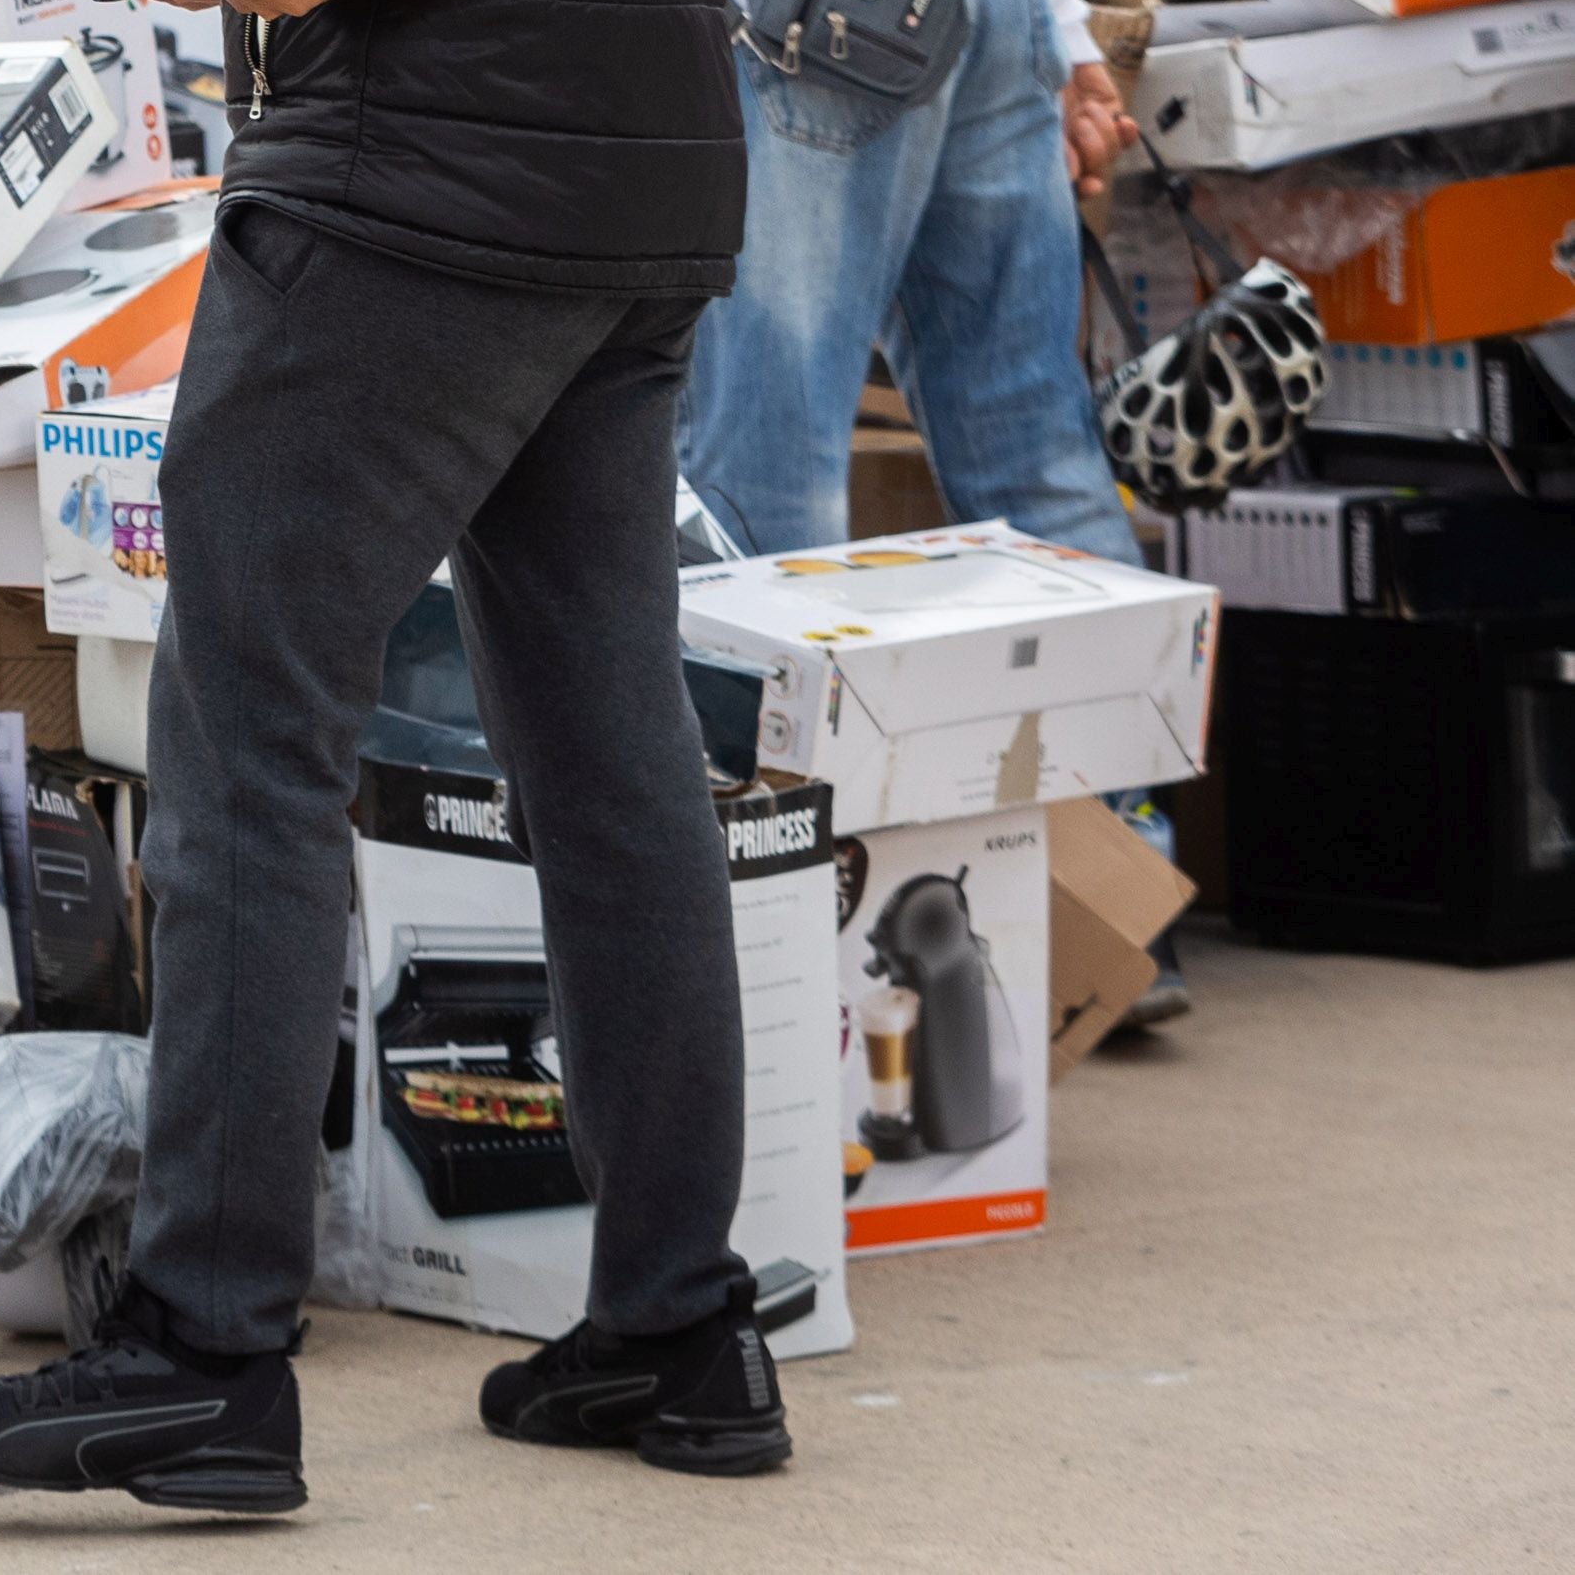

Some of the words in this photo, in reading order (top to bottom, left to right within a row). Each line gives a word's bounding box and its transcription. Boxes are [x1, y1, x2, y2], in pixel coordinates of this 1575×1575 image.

[42, 423, 163, 461] PHILIPS
[438, 795, 511, 844] PRINCE
[728, 808, 817, 863] PRINCESS
[984, 828, 1038, 851] KRUPS
[411, 1243, 467, 1278] GRILL
